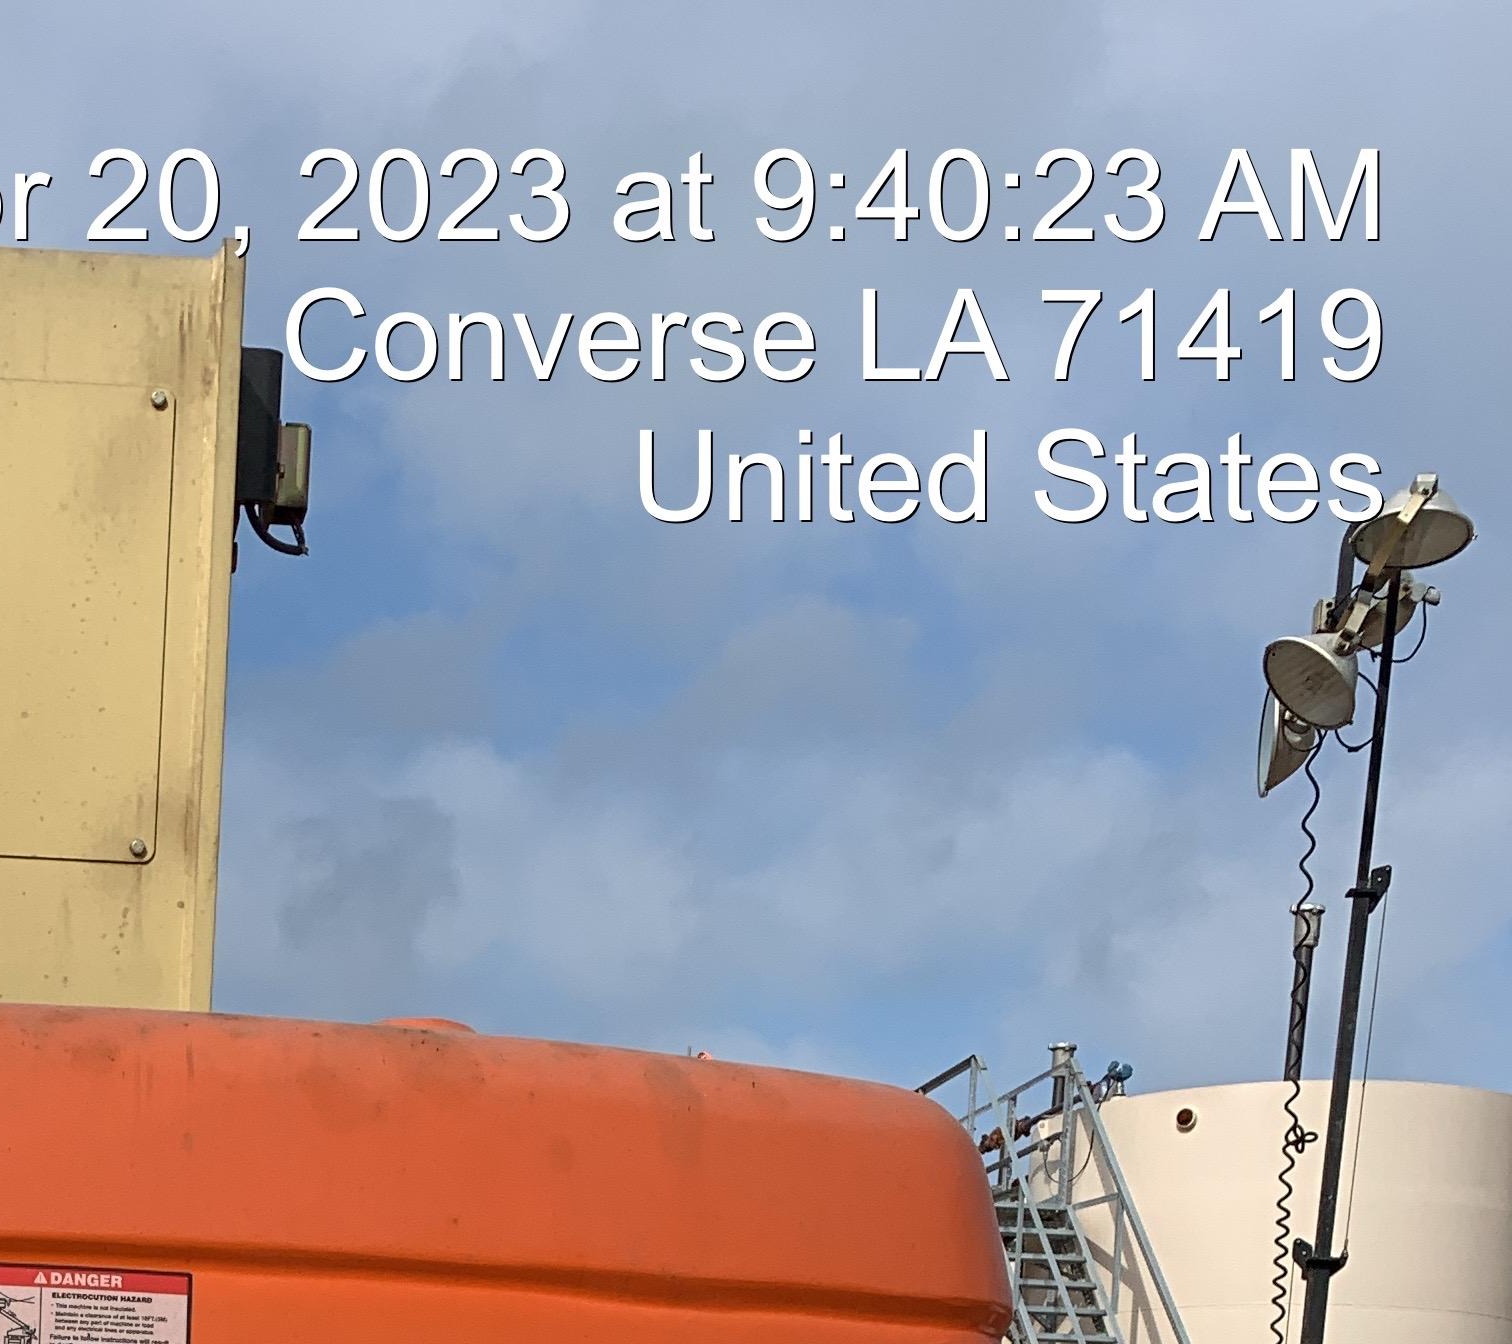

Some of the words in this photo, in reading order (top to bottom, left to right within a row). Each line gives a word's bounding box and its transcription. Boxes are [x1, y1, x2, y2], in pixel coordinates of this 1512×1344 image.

[50, 1271, 123, 1289] DANGER
[51, 1292, 118, 1302] ELECTROCUTION
[120, 1296, 153, 1304] HAZARD
